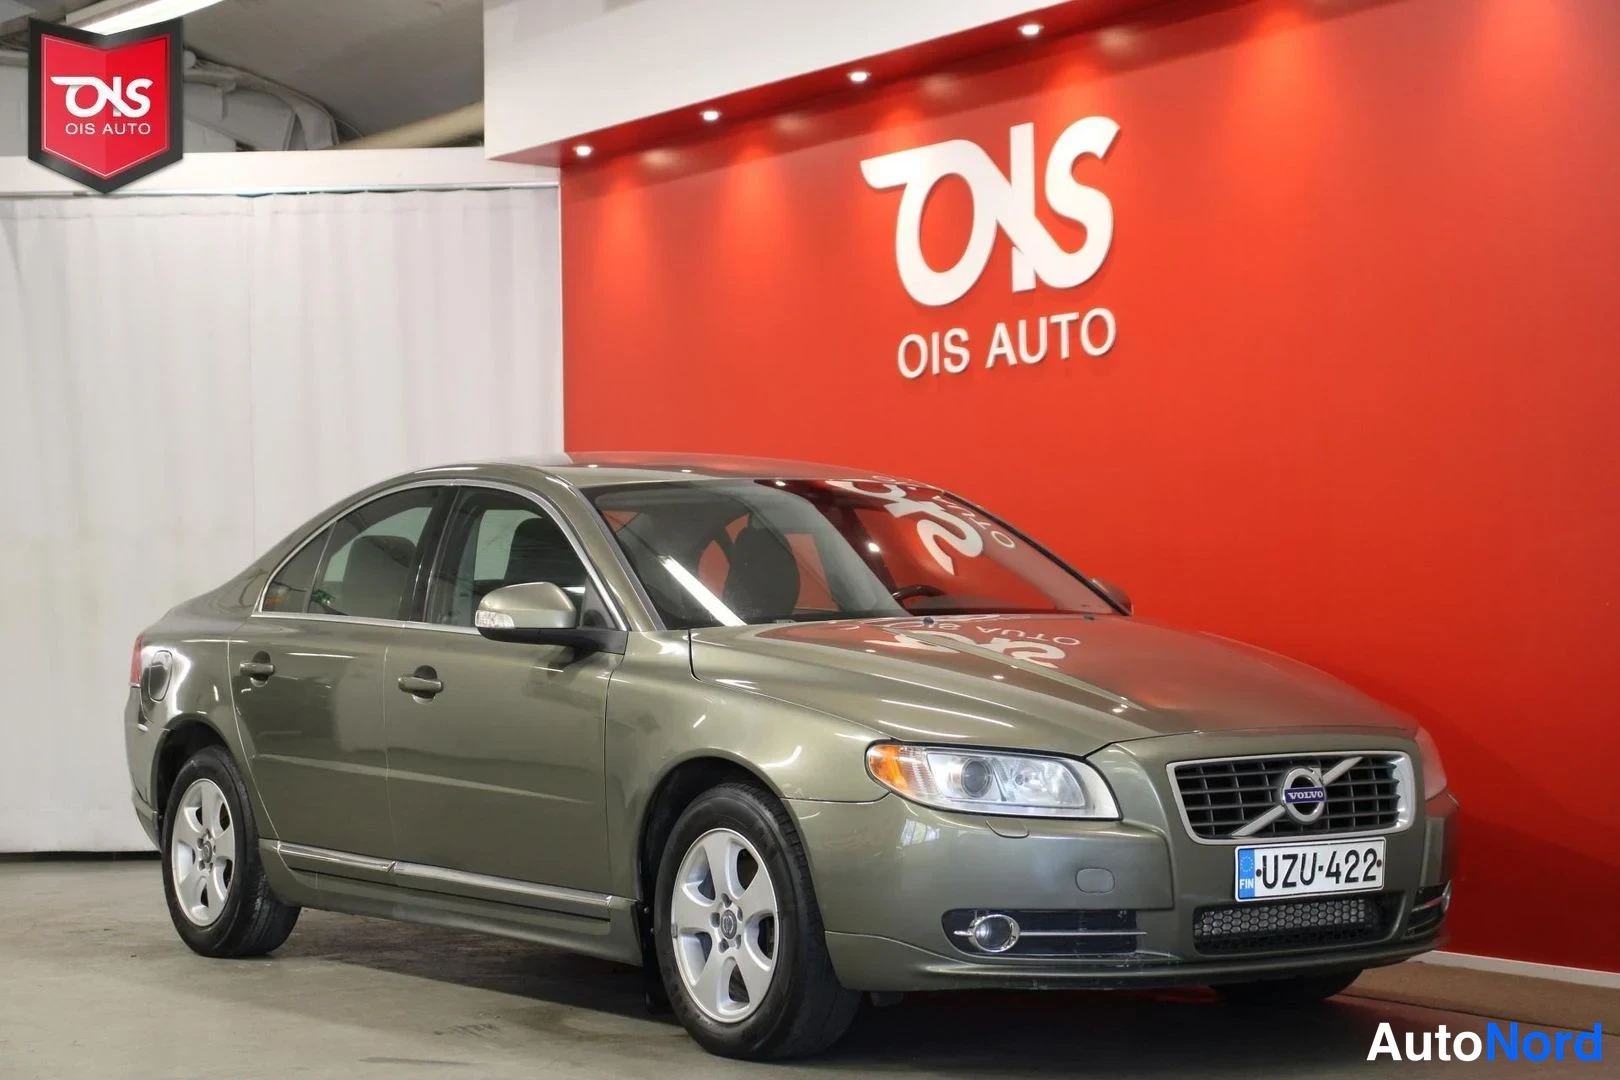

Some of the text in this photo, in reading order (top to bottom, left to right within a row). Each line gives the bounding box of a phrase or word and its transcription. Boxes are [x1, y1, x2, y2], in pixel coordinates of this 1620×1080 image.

[897, 307, 1116, 379] OIS AUTO
[1288, 790, 1324, 800] VOLVO
[1262, 848, 1378, 889] UZU-422
[1239, 878, 1254, 890] FIN
